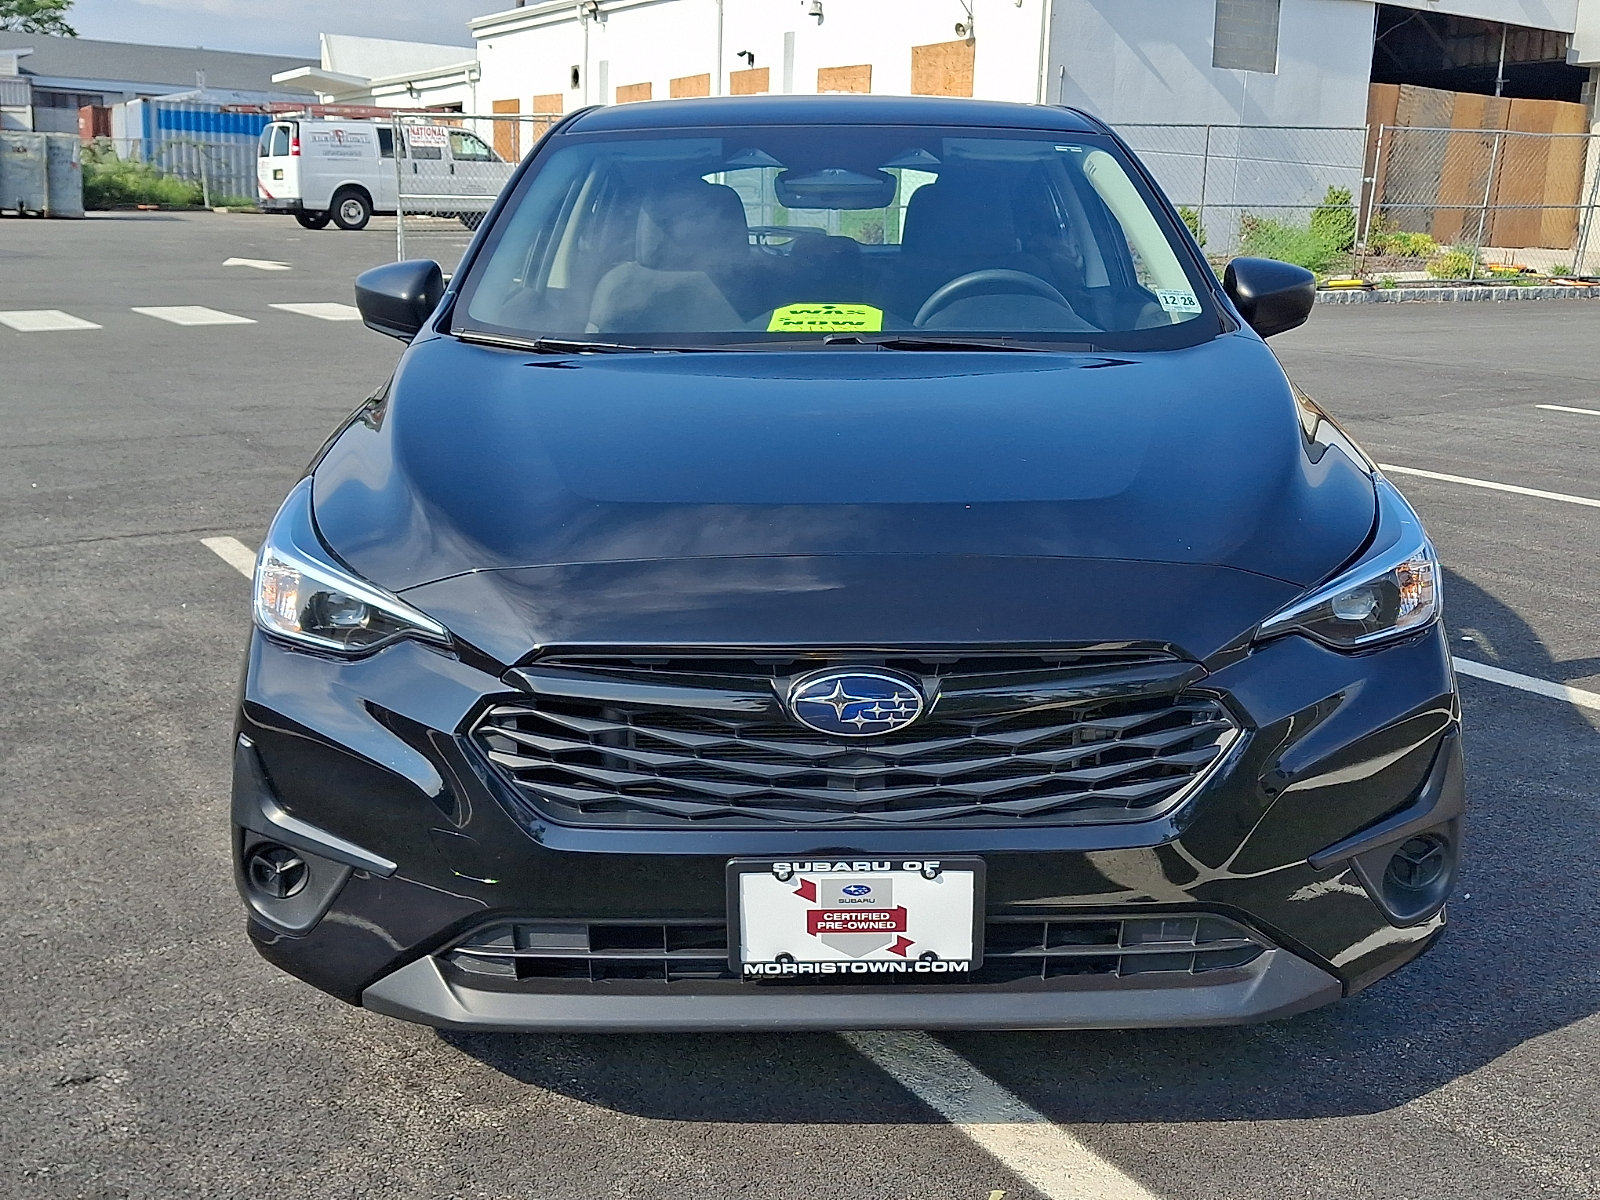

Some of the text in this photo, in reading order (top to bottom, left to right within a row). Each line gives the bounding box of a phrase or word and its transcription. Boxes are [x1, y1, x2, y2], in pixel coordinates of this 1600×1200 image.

[411, 127, 446, 136] NATIONAL
[1162, 296, 1196, 306] 12 28
[773, 860, 940, 872] SUBARU OF
[823, 912, 890, 922] CERTIFIED
[817, 921, 897, 930] PRE-OWNED
[743, 961, 969, 975] MORRISTOWN.COM
